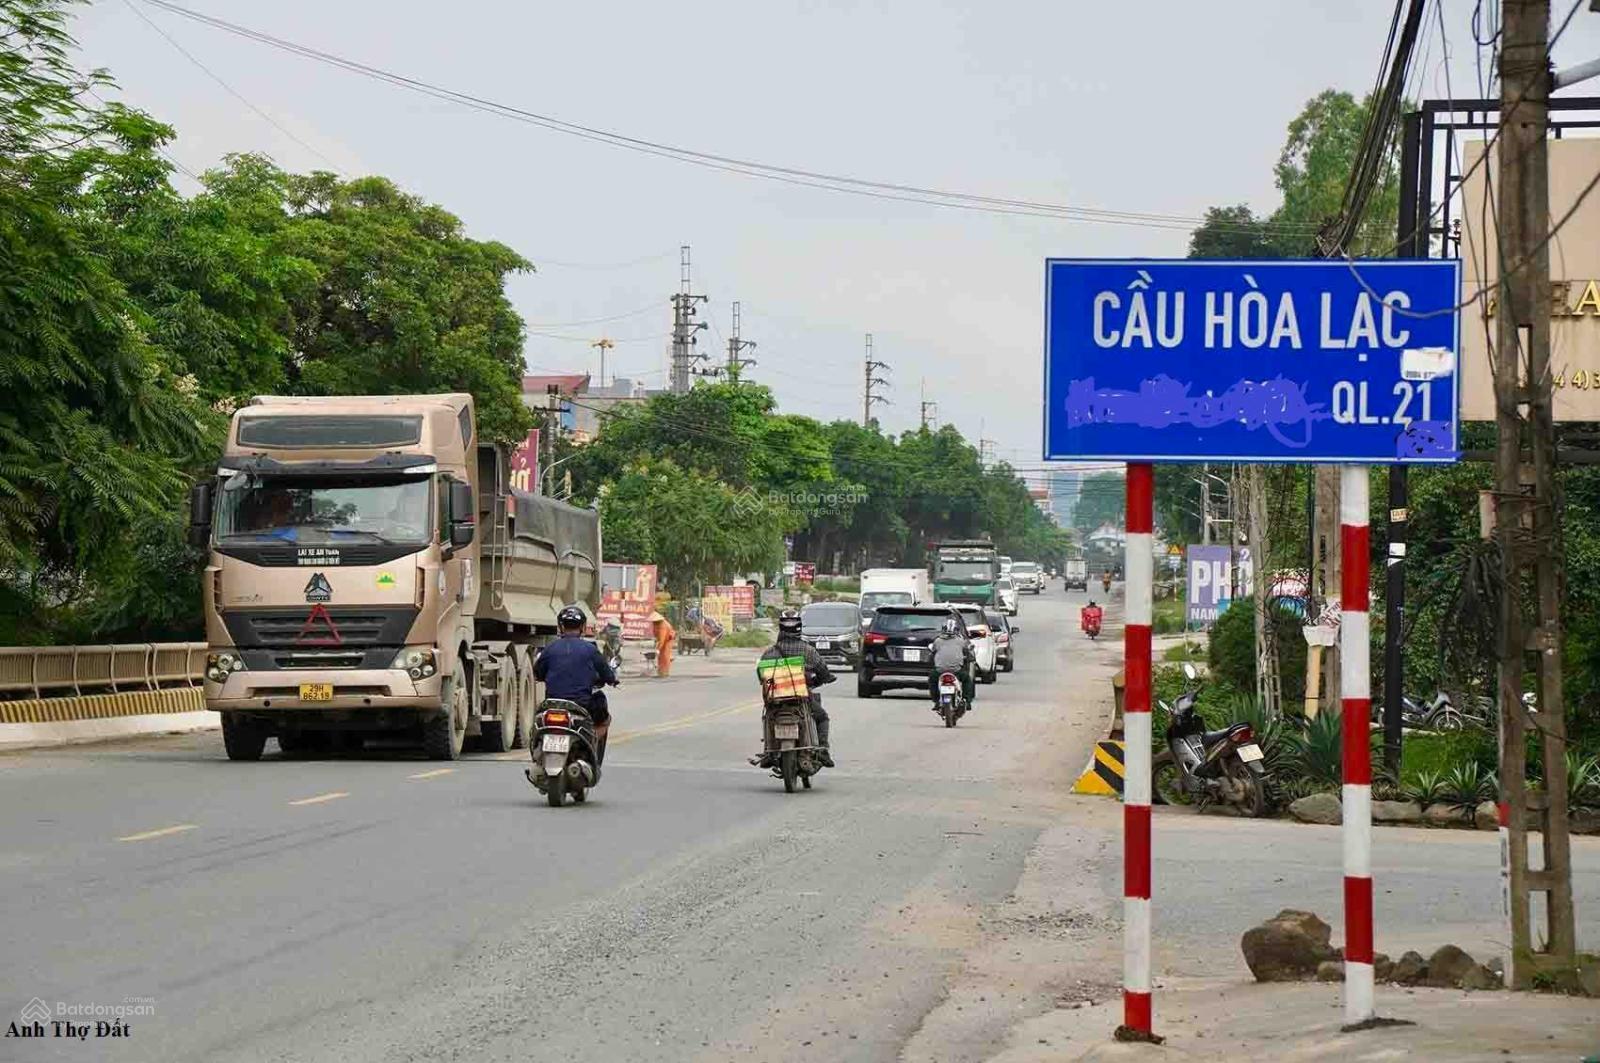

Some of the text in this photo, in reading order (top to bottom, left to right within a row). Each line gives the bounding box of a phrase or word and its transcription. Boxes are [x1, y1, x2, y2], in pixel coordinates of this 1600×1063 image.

[1093, 270, 1411, 362] CẦU HÒA LẠC
[1332, 381, 1432, 425] QL.21
